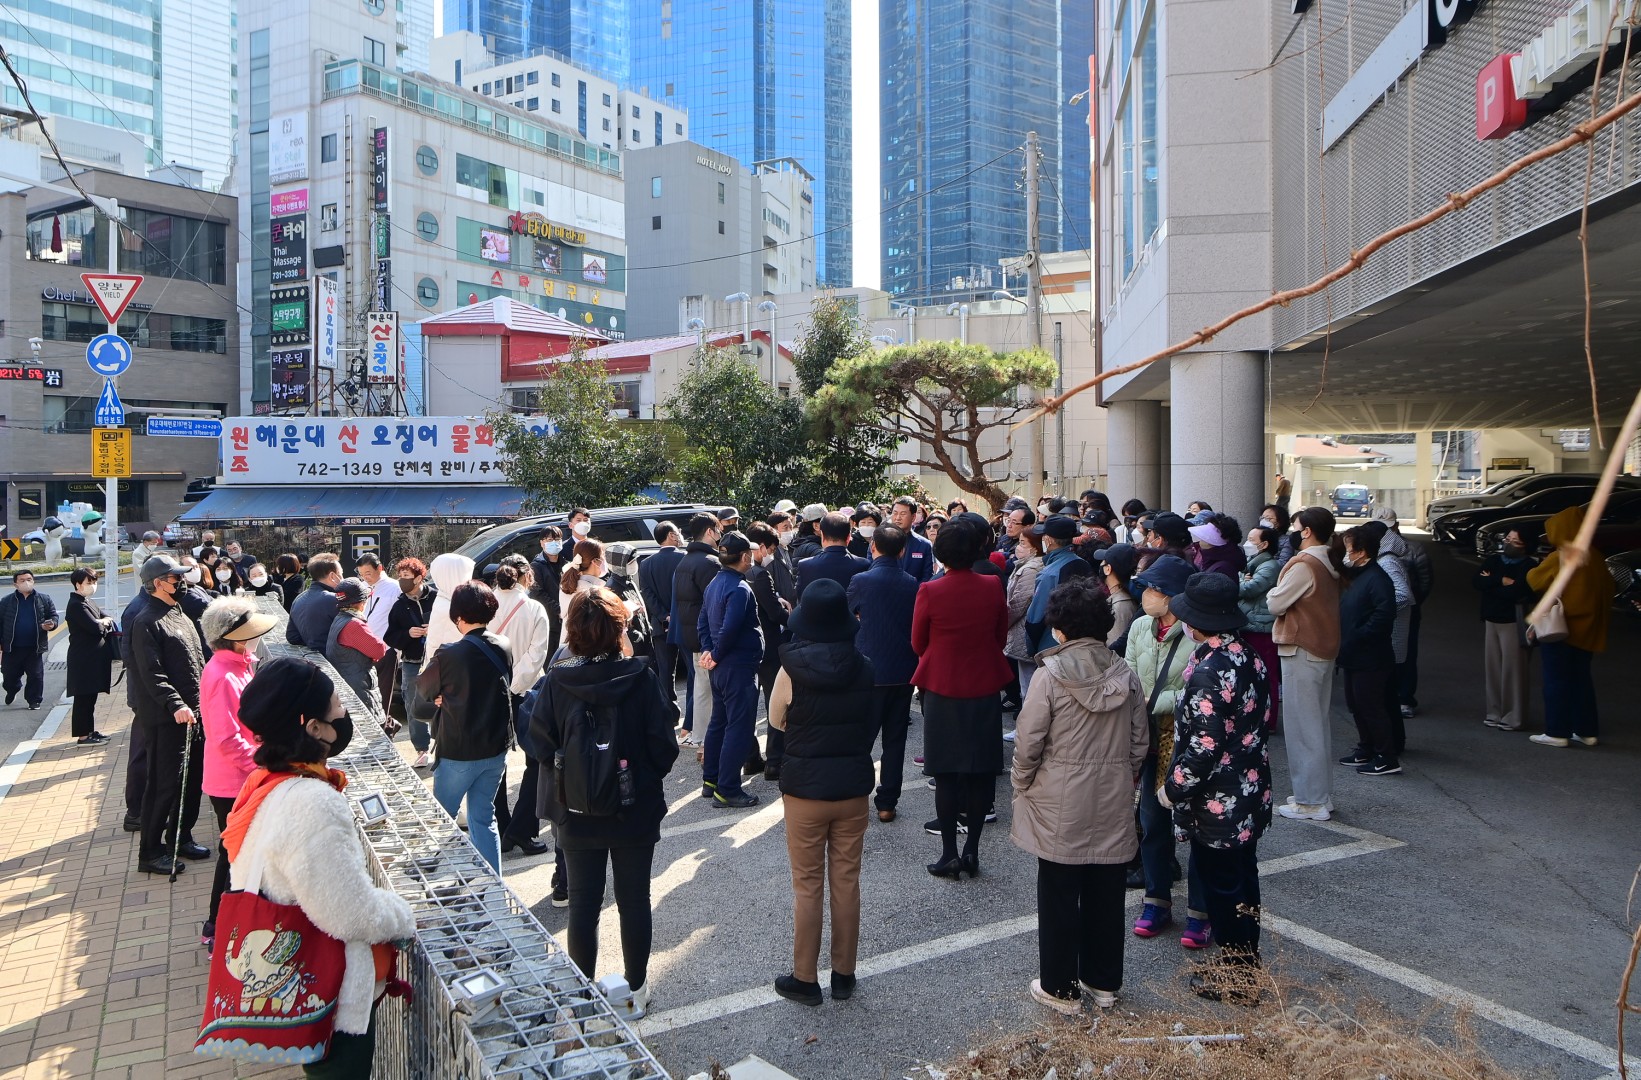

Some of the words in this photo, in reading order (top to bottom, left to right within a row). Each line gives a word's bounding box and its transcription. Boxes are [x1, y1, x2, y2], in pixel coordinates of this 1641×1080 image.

[1484, 75, 1496, 122] P
[697, 156, 716, 170] HOTEL
[273, 246, 288, 256] Thai
[274, 256, 301, 267] Massage
[98, 282, 124, 291] 양보
[43, 286, 77, 302] Chef
[104, 291, 120, 299] YIELD
[370, 313, 393, 322] 해운대
[272, 352, 303, 364] 라운딩
[46, 370, 60, 386] 岩
[255, 424, 325, 454] 해운대
[338, 424, 360, 454] 산
[371, 424, 438, 454] 오징어
[230, 426, 250, 472] 원조
[297, 462, 383, 476] 742-1349
[393, 460, 432, 477] 단체석
[440, 460, 466, 477] 완비
